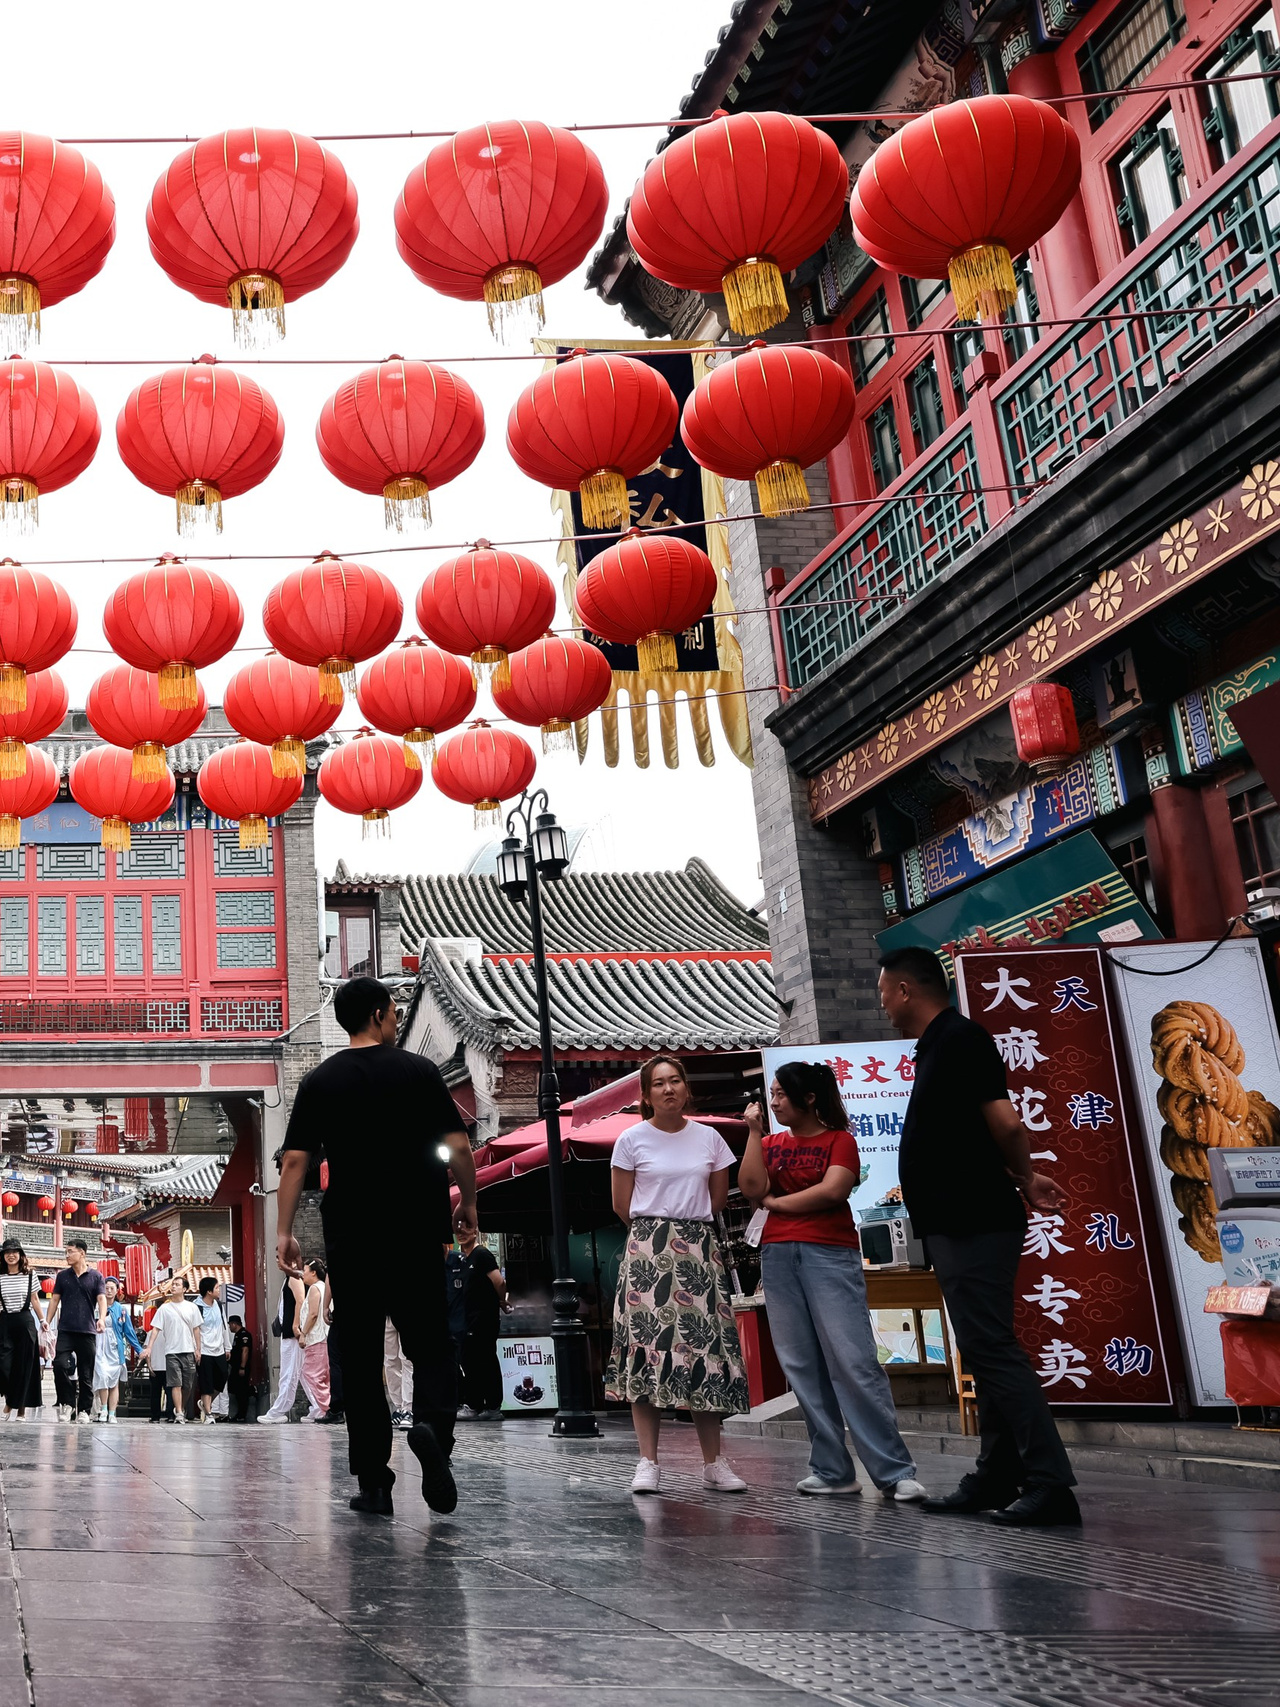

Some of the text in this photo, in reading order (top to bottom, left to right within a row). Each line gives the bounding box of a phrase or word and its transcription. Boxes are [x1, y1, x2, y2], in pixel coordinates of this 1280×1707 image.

[1024, 882, 1111, 939] MODERN
[824, 1054, 917, 1087] 津文创
[841, 1089, 913, 1100] ultural Creati
[849, 1111, 904, 1137] 箱贴
[1050, 975, 1155, 1377] 天津礼物
